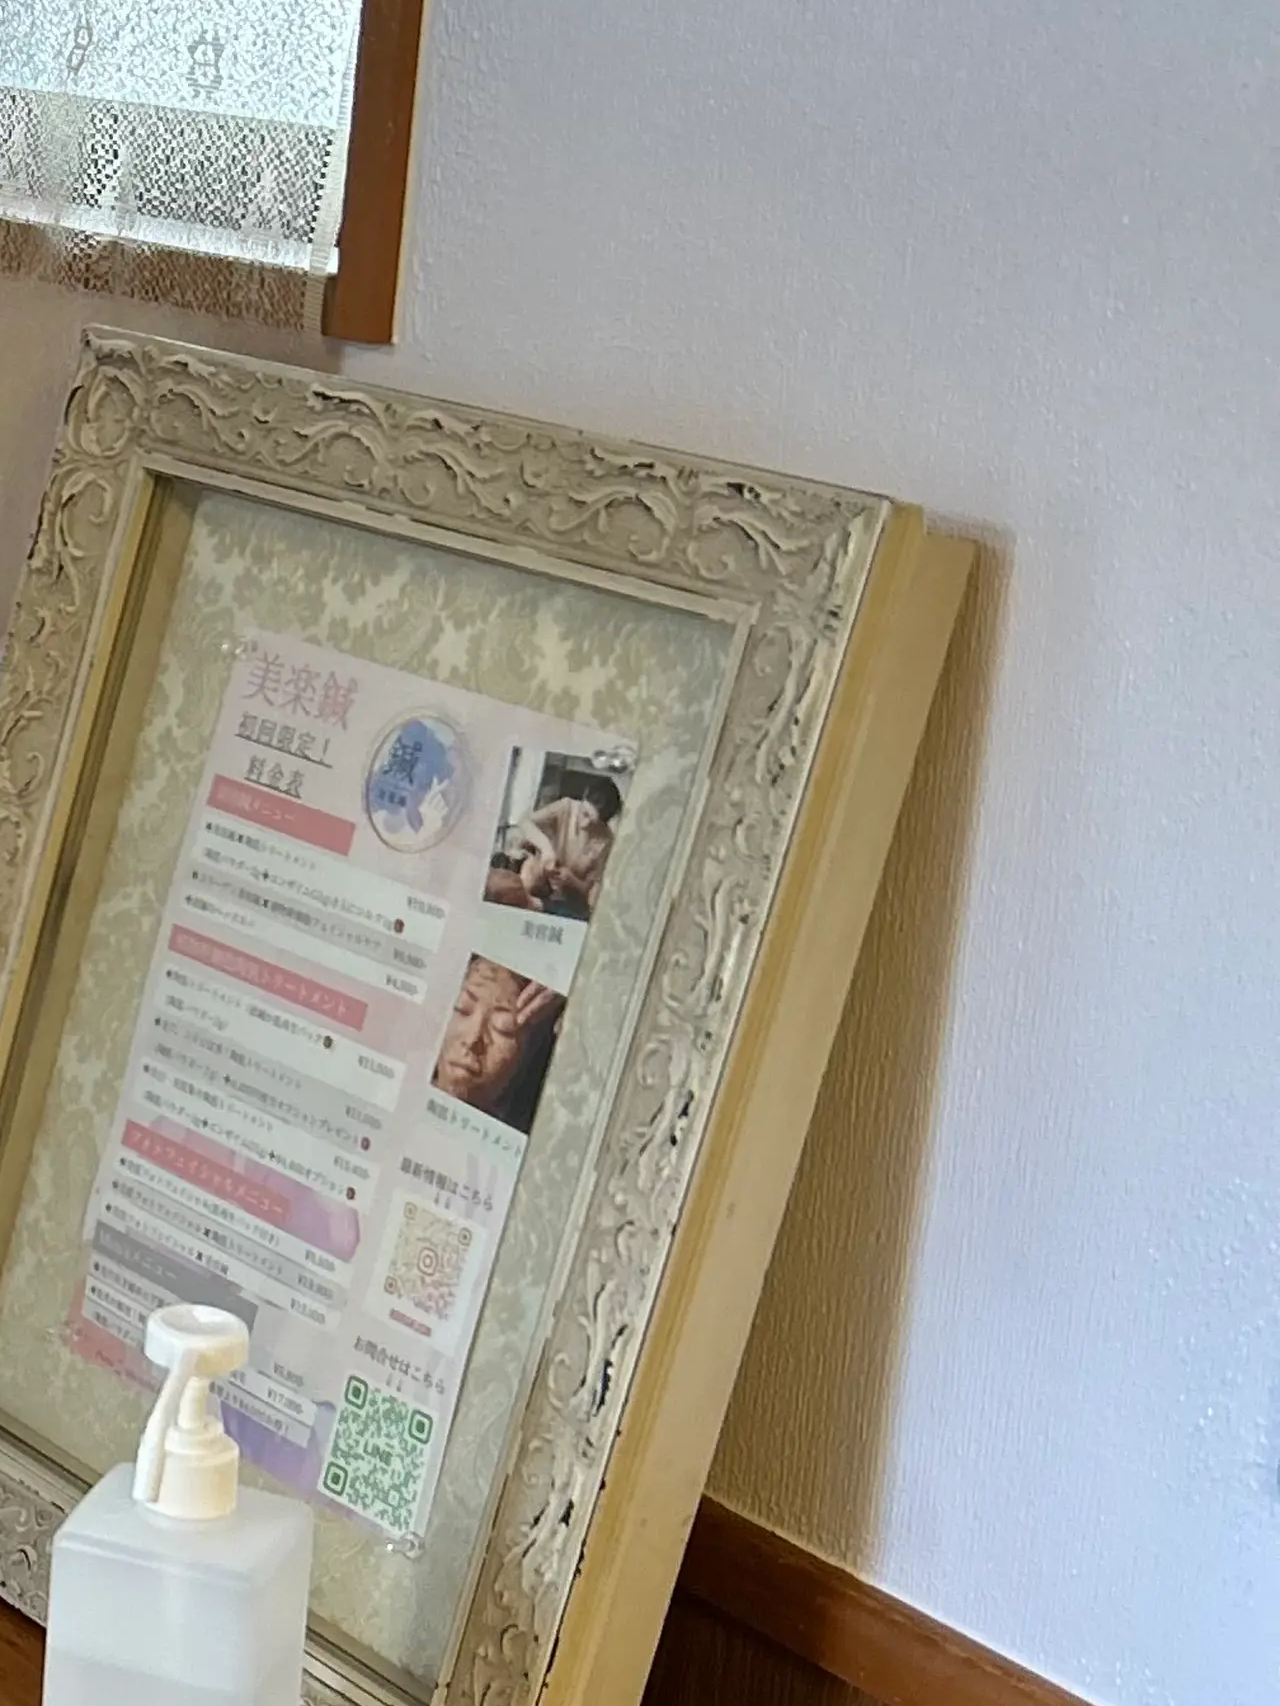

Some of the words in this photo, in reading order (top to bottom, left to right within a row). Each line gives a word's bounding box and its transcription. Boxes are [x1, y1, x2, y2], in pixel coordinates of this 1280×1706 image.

[242, 651, 358, 732] 美楽鍼
[246, 755, 305, 798] 料金表
[400, 1156, 494, 1212] 最新情報はこちら
